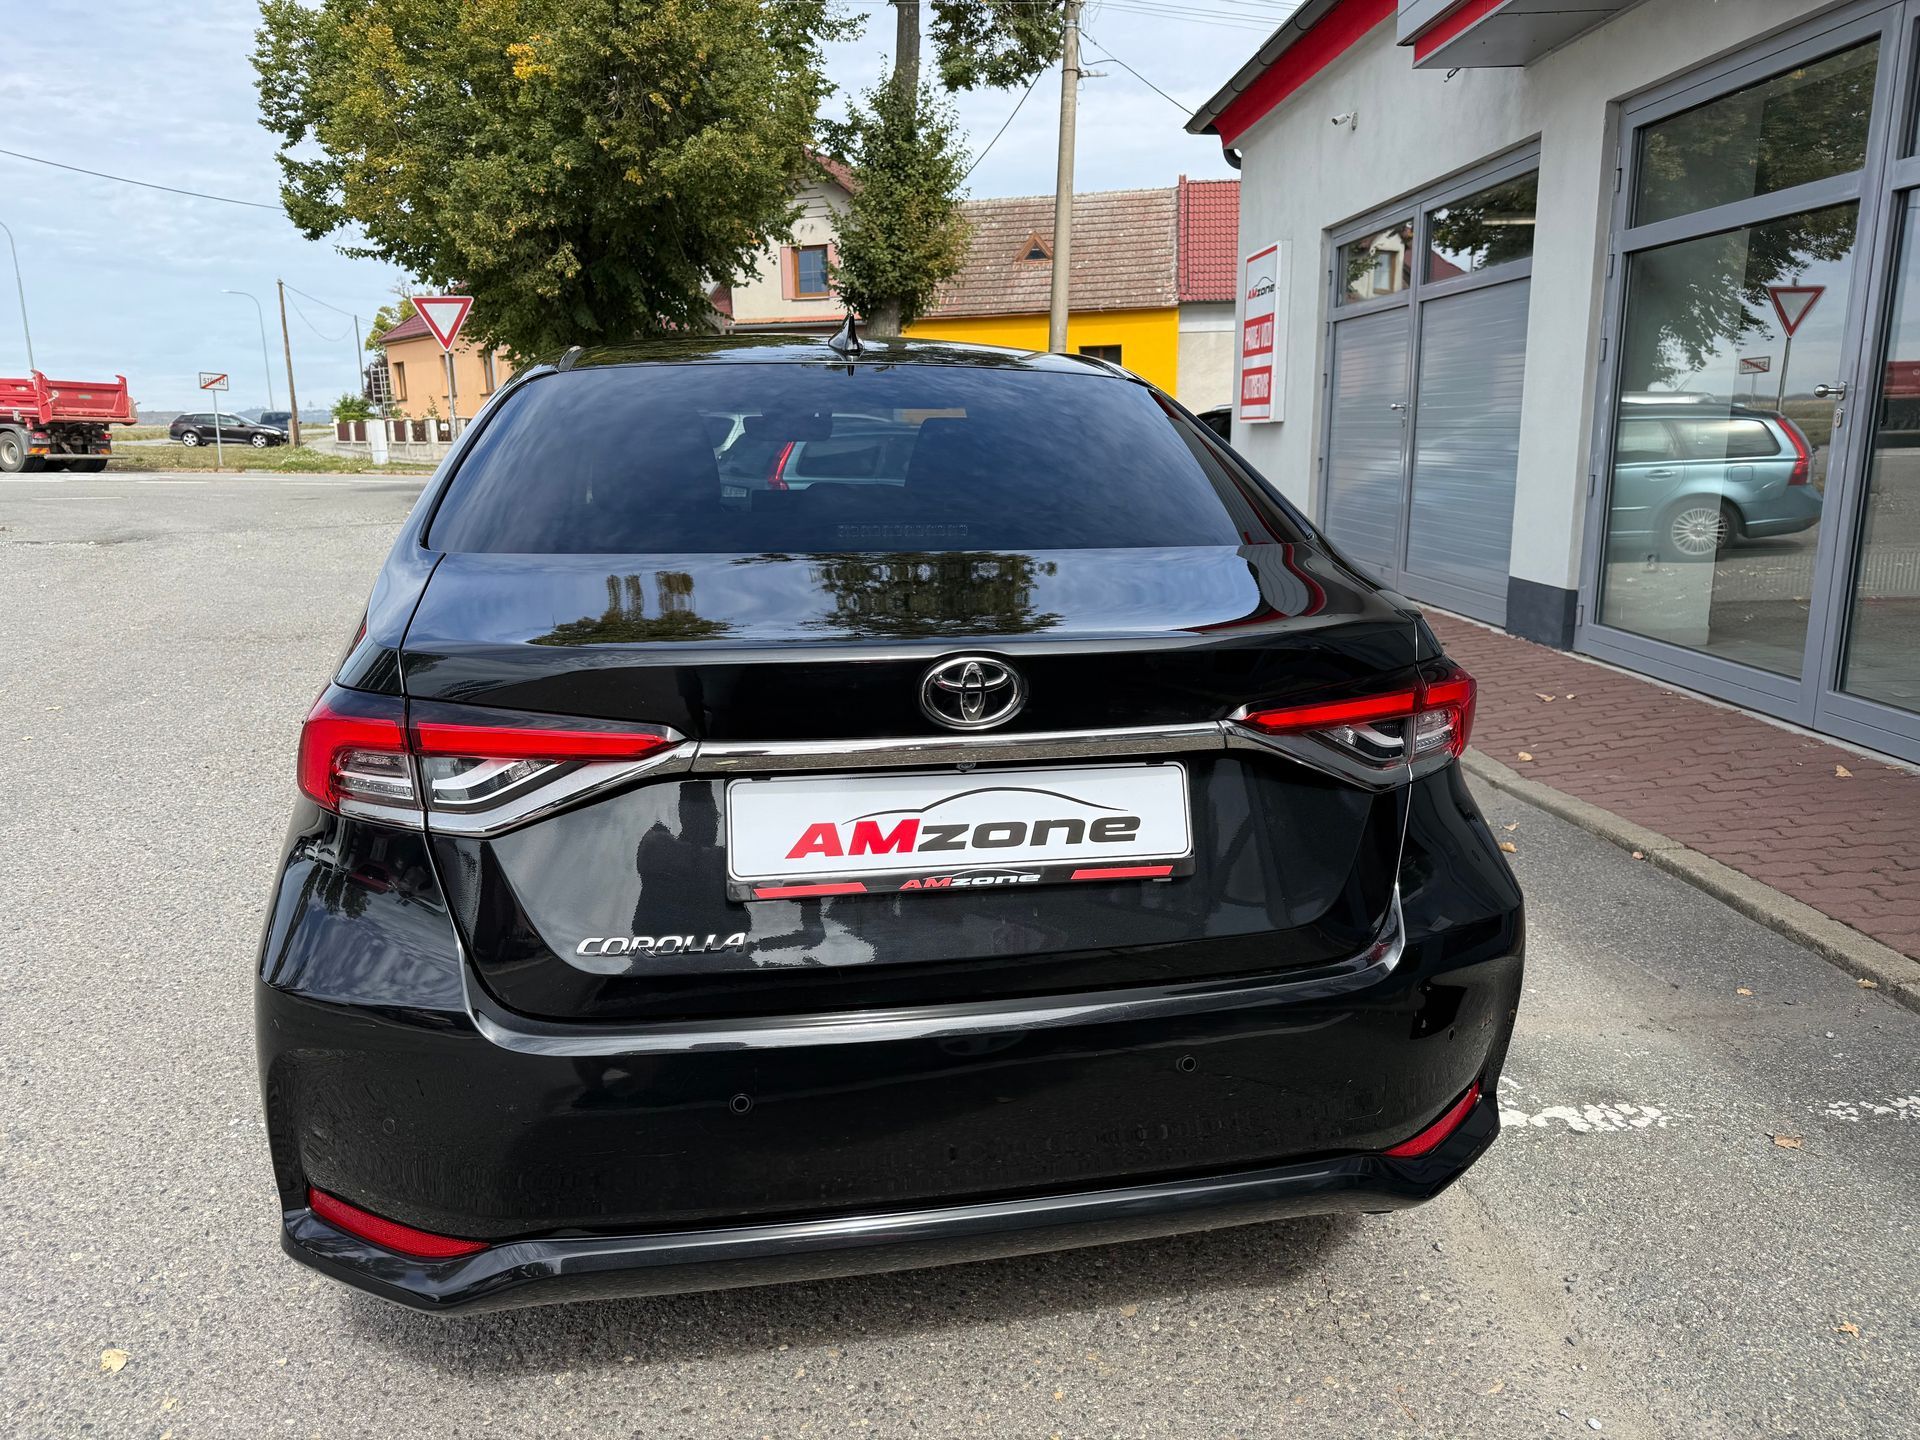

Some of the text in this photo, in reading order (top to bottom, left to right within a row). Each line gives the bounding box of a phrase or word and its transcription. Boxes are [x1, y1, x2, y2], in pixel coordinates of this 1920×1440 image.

[1248, 284, 1275, 300] AMzone
[785, 815, 1141, 860] AMzone
[899, 872, 1041, 890] AMzone
[576, 932, 747, 958] COROLLA
